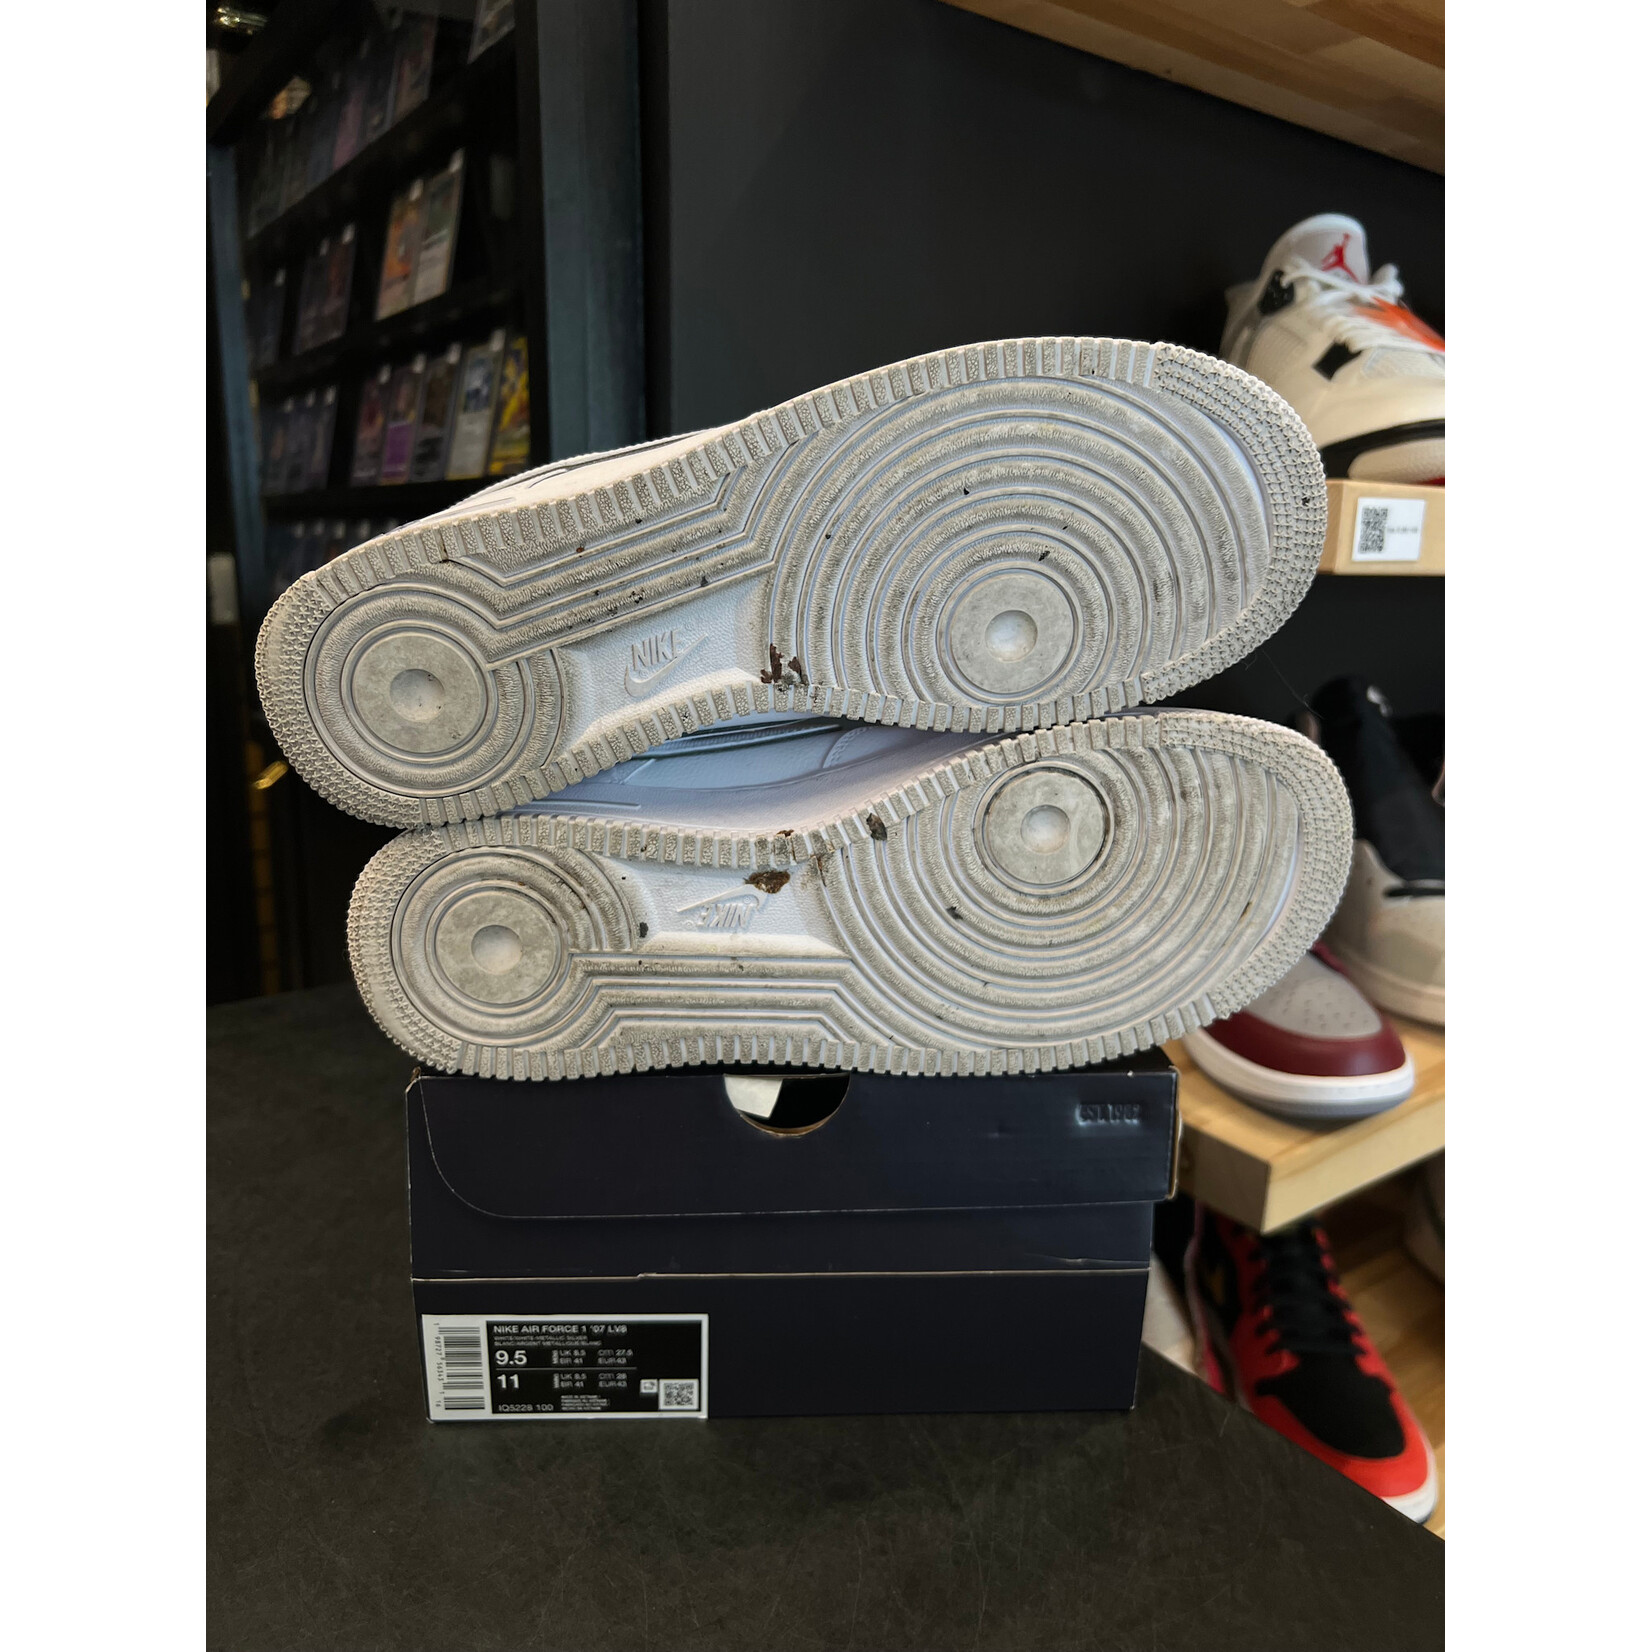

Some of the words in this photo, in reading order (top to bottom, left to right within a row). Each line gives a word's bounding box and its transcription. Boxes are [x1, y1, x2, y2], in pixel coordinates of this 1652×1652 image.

[631, 629, 682, 672] NIKE
[696, 902, 756, 928] NIKE
[493, 1325, 518, 1333] NIKE
[520, 1325, 540, 1333] AIR
[541, 1325, 579, 1333] FORCE
[580, 1325, 587, 1333] 1
[589, 1325, 606, 1334] '07
[607, 1325, 628, 1334] LV8
[495, 1350, 528, 1365] 9.5
[614, 1349, 633, 1357] 27.5
[497, 1374, 519, 1389] 11
[498, 1404, 533, 1412] IQ5228
[536, 1404, 554, 1412] 100
